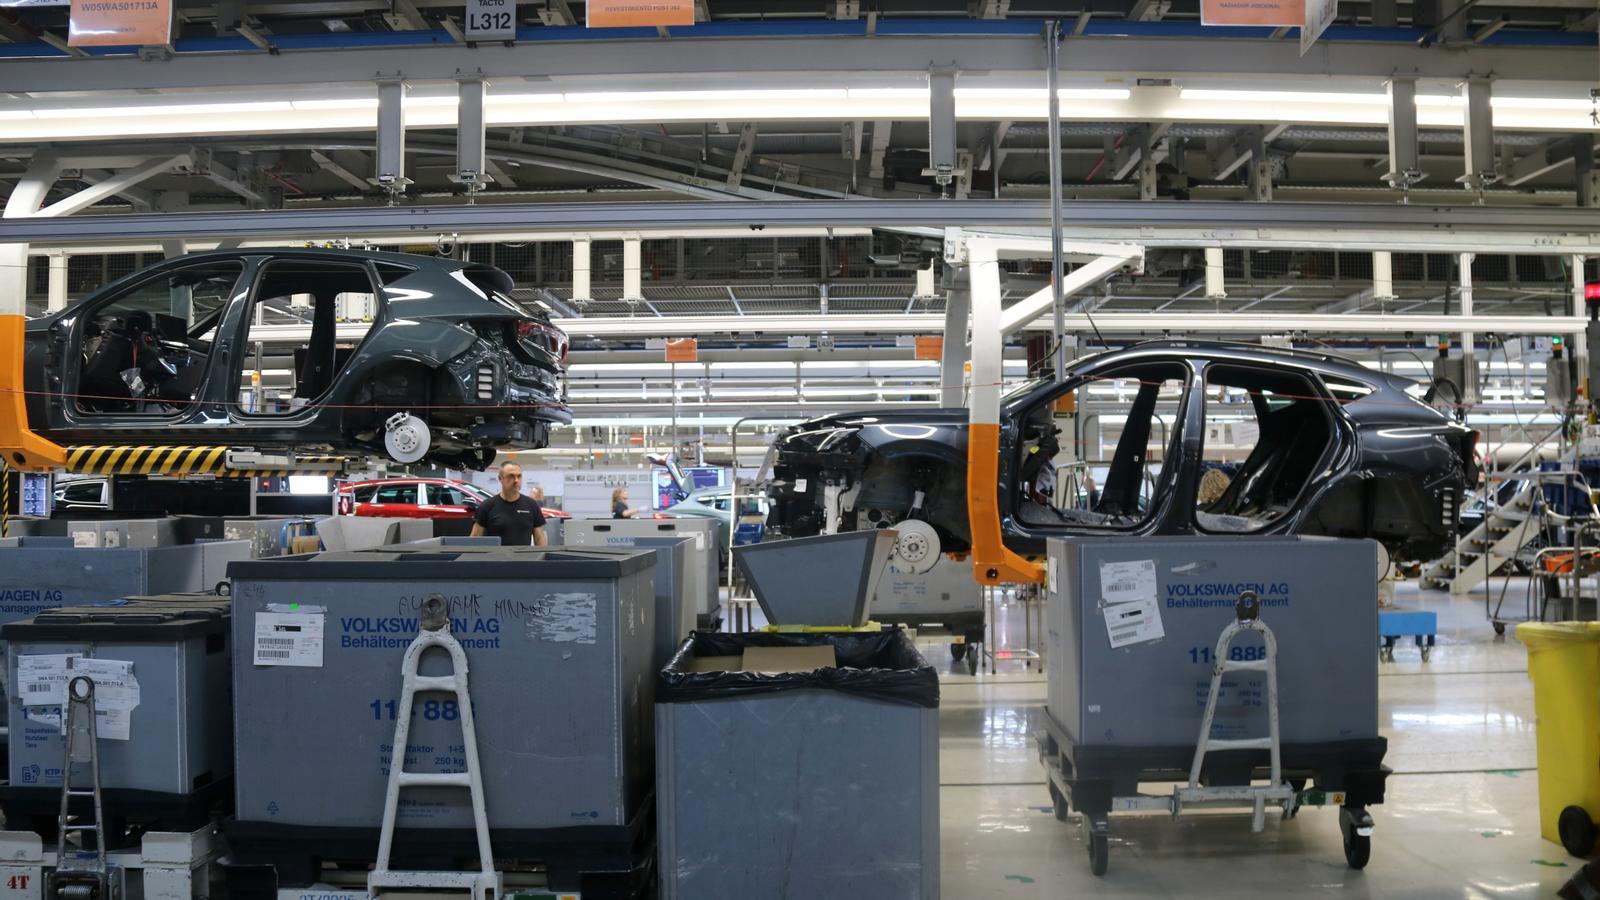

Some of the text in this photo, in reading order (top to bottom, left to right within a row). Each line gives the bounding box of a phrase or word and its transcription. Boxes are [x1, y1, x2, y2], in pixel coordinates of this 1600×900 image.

[470, 13, 511, 30] L312
[44, 590, 62, 601] AG
[1269, 583, 1288, 595] AG
[473, 617, 499, 632] AG
[435, 756, 451, 765] 250
[453, 756, 464, 767] kg
[6, 875, 29, 890] 4T
